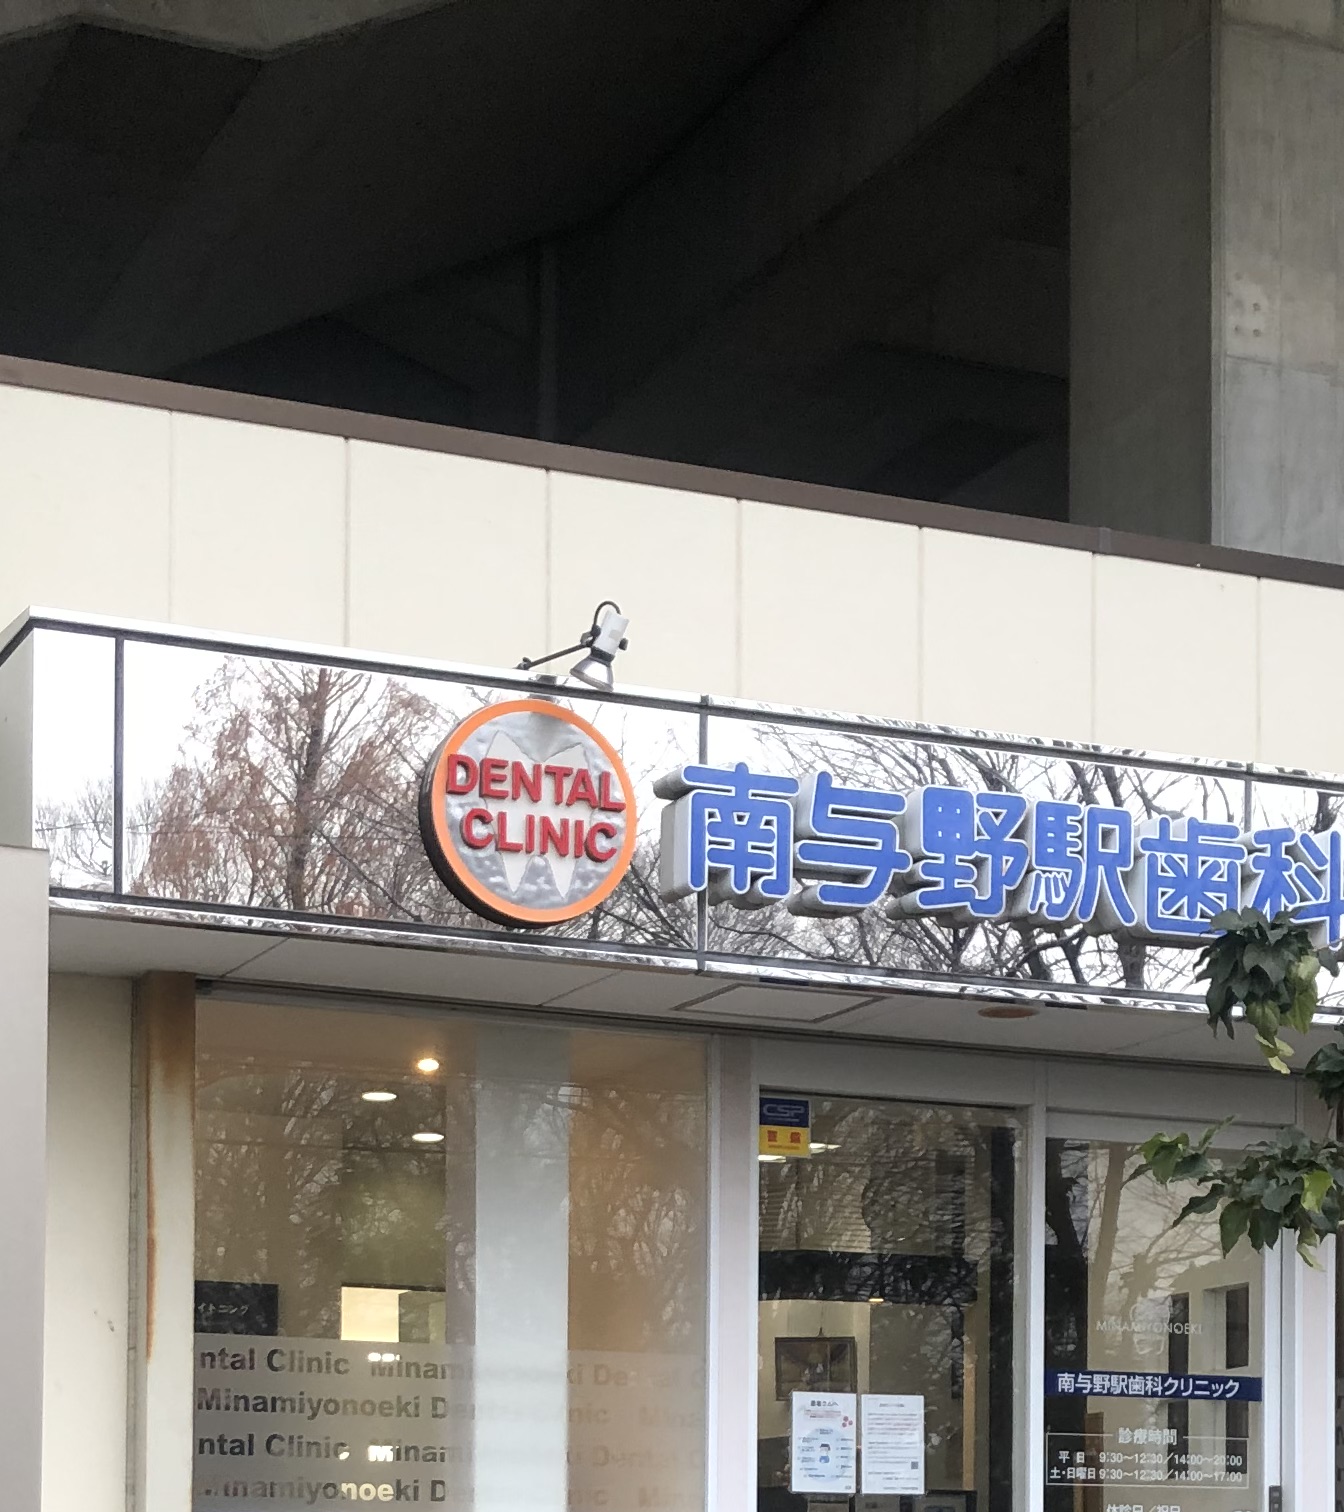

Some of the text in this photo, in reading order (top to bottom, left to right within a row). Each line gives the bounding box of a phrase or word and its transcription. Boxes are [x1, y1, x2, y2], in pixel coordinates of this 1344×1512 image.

[445, 752, 627, 813] DENTAL
[460, 806, 618, 864] CLINIC
[762, 1104, 806, 1117] CSP
[266, 1348, 350, 1377] Clinic
[1056, 1372, 1240, 1398] 南与野駅歯科クリニック
[197, 1386, 421, 1421] Minamiyonoeki
[265, 1433, 350, 1461] Clinic
[1118, 1427, 1178, 1446] 診療時間
